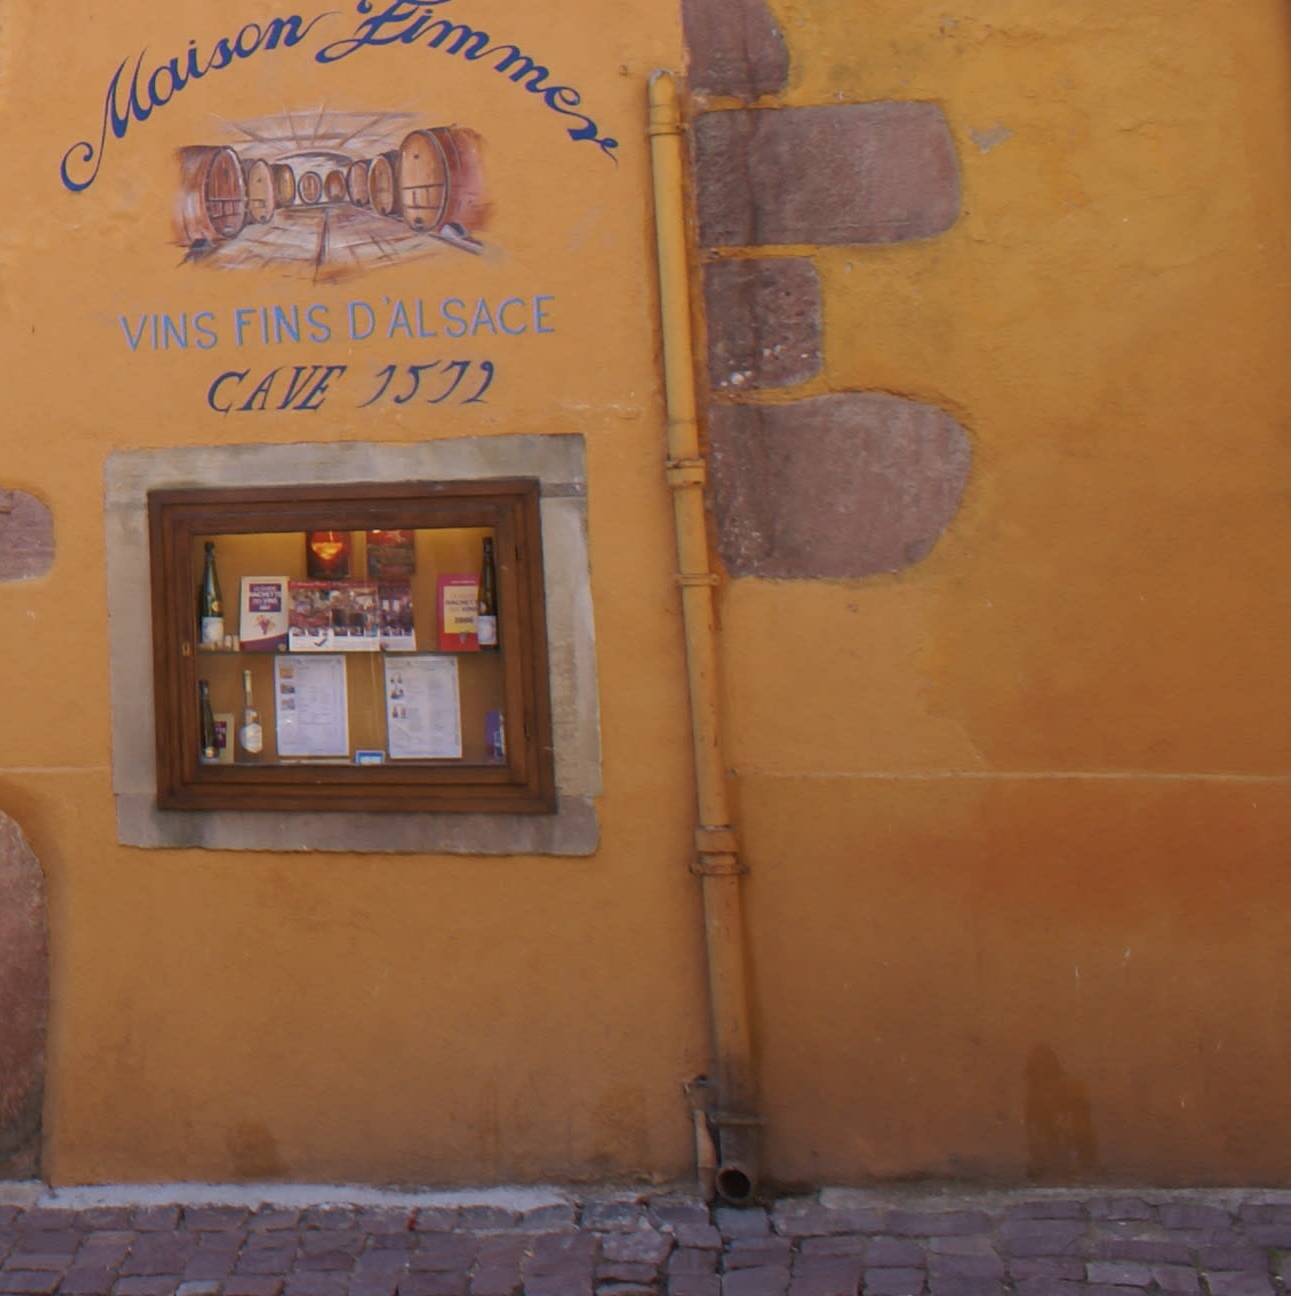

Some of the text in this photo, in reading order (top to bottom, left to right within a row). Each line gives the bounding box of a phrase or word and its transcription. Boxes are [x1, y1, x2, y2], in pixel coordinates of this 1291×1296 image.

[60, 11, 341, 192] Maison
[118, 295, 556, 352] VINS FINS D'ALSACE
[206, 364, 347, 412] CAVE
